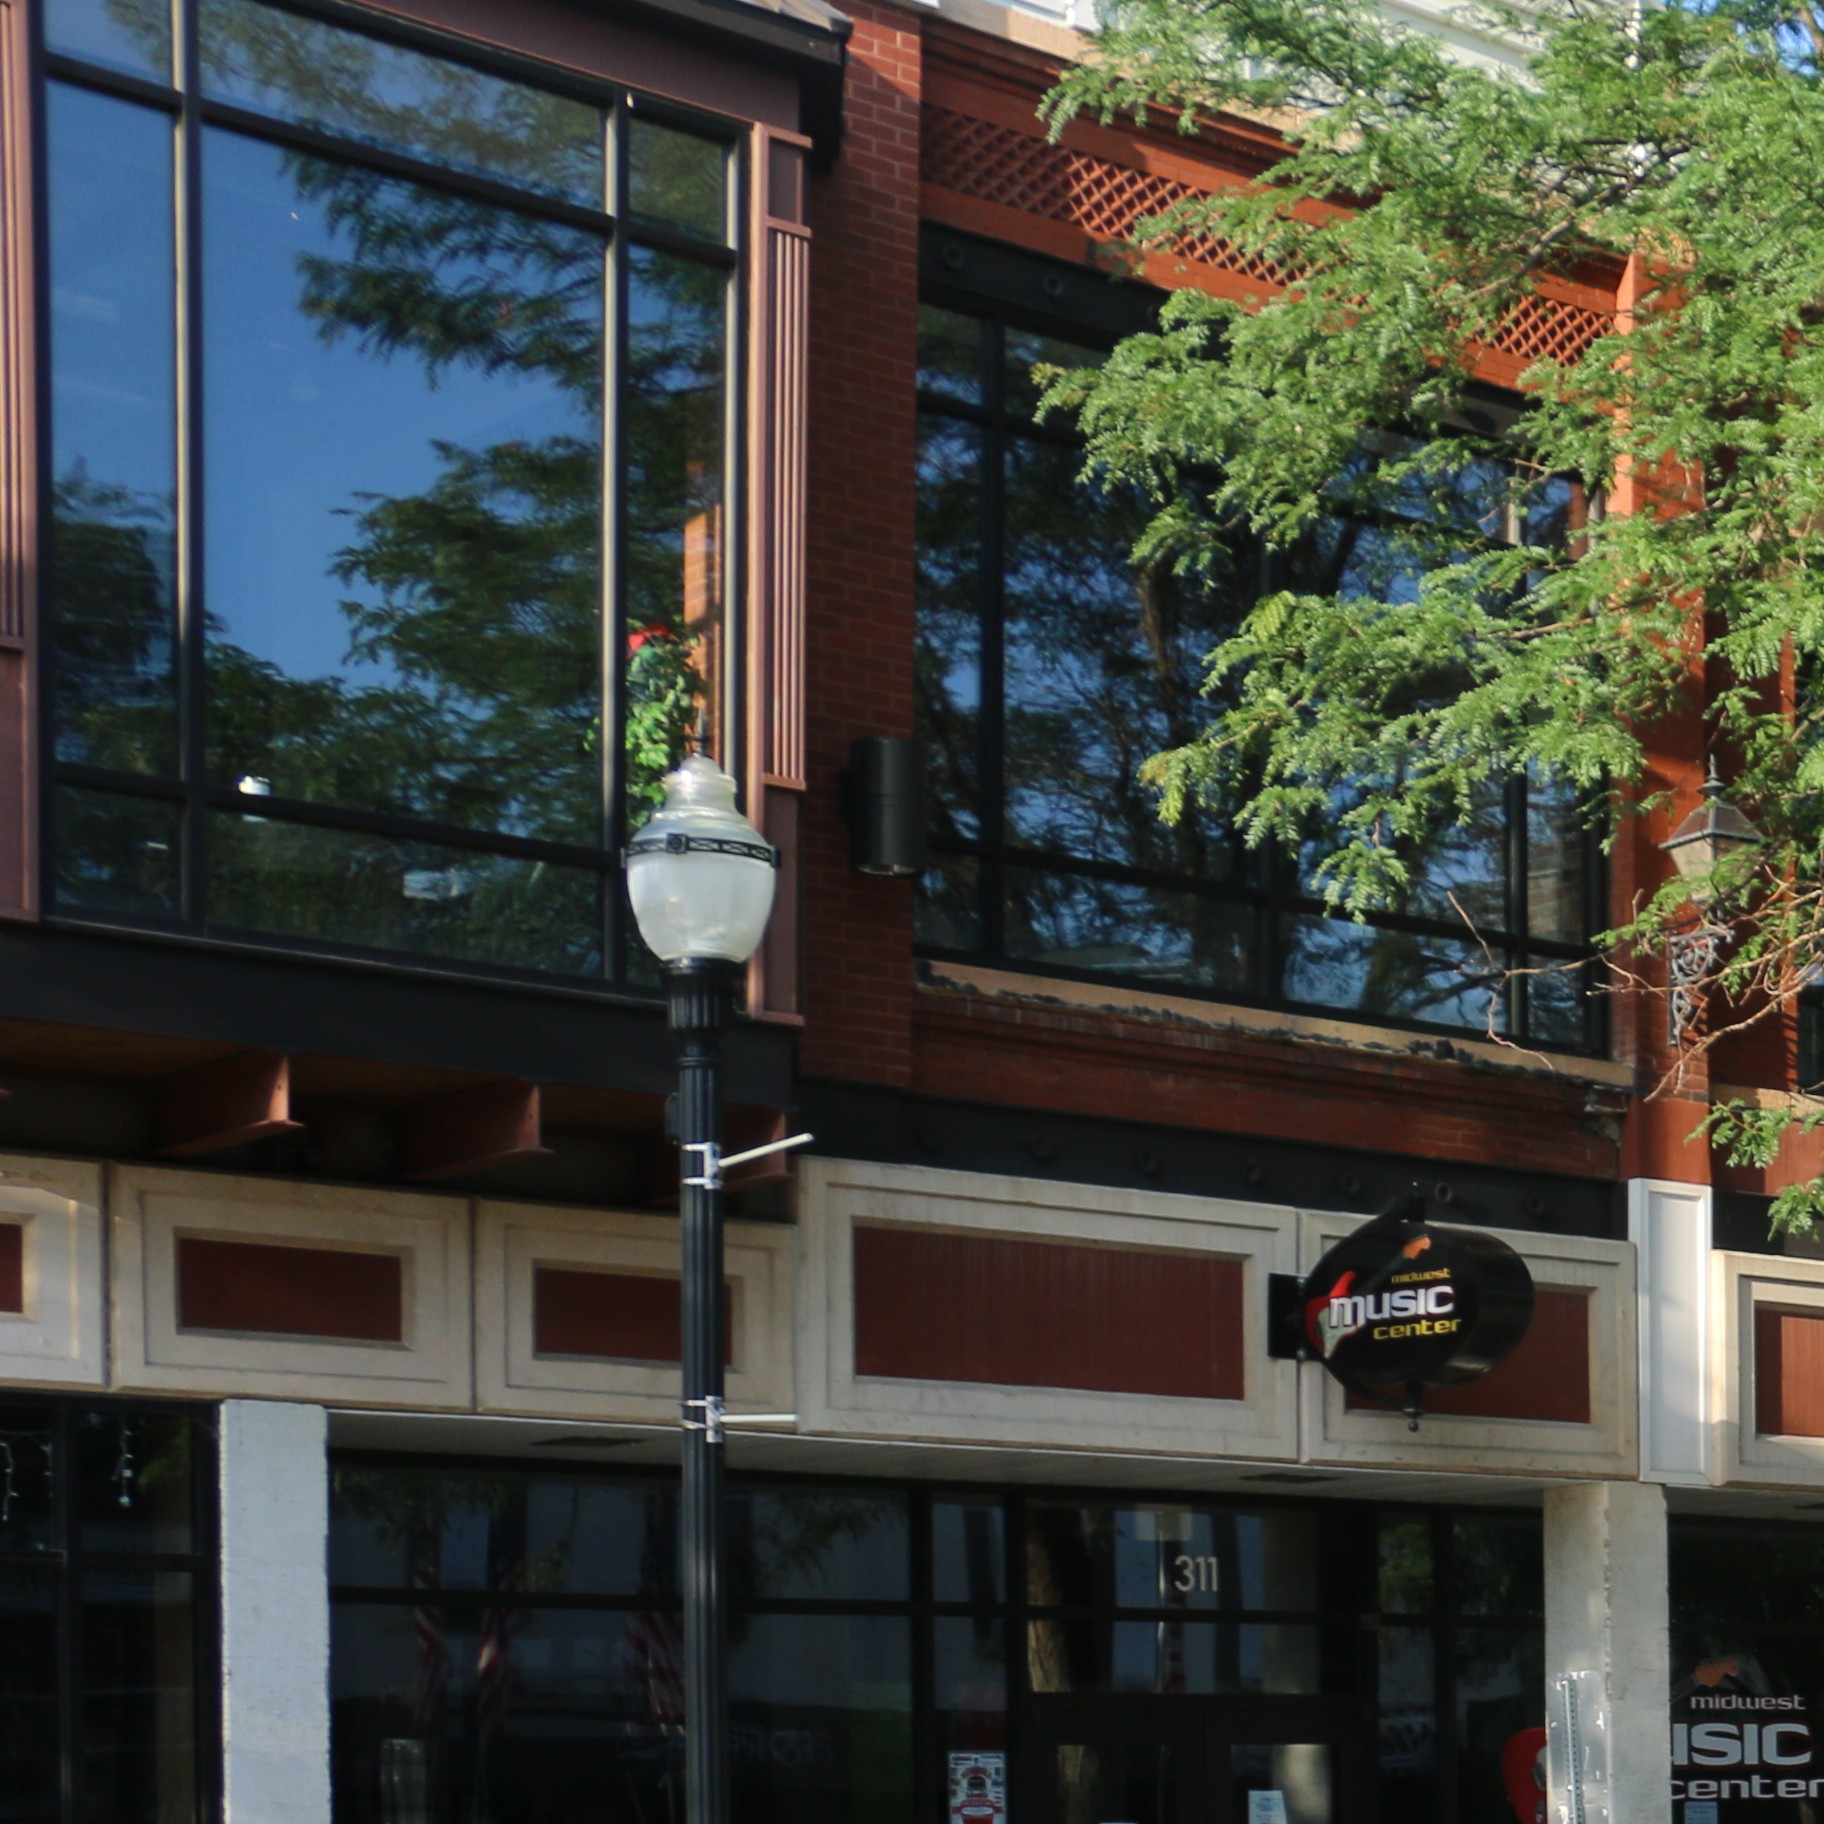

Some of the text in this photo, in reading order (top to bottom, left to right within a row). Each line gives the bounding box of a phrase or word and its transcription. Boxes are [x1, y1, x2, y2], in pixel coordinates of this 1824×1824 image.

[1391, 1267, 1451, 1284] midwest
[1373, 1318, 1462, 1340] center
[1174, 1555, 1218, 1592] 311
[1690, 1694, 1806, 1710] midwest
